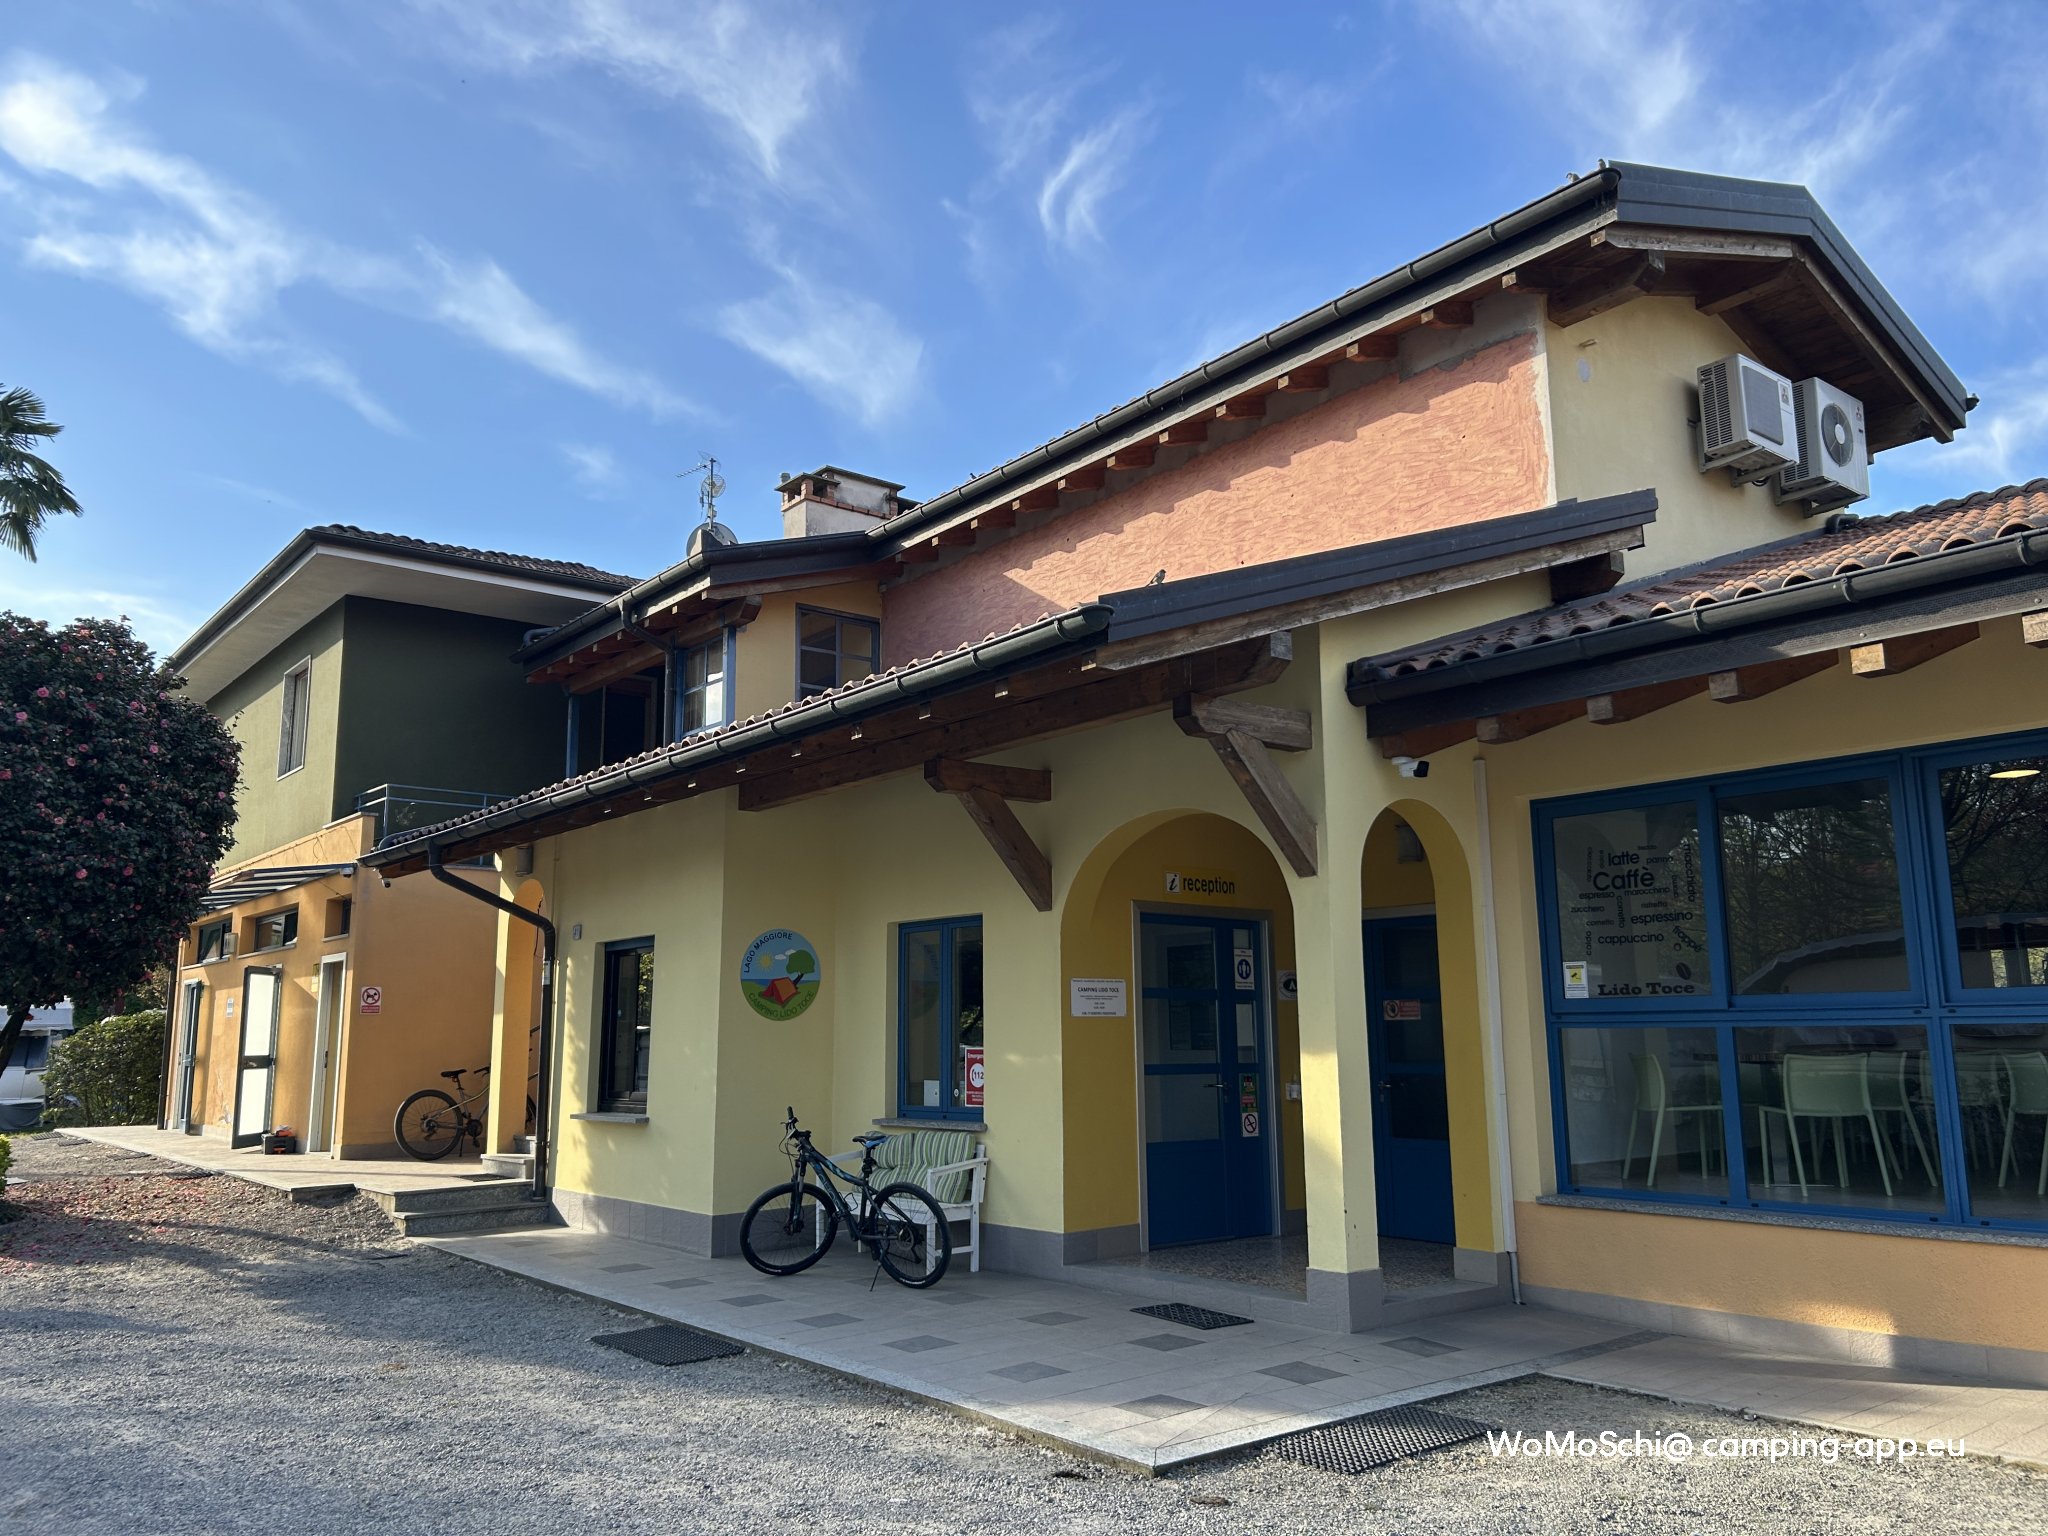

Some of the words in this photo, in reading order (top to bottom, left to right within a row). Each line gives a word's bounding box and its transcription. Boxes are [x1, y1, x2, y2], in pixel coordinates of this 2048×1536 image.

[1608, 851, 1640, 866] latte
[1183, 876, 1235, 896] reception
[1593, 866, 1655, 891] Caffè
[1578, 891, 1615, 900] espresso
[1624, 886, 1670, 897] marocchino
[1570, 904, 1605, 913] zucchero
[1630, 911, 1693, 926] espressino
[1597, 932, 1664, 945] cappuccino
[743, 950, 756, 973] LAGO
[753, 931, 793, 950] MAGGIORE
[1598, 984, 1642, 996] Lido
[1645, 982, 1696, 995] Toce
[748, 992, 779, 1017] CAMPING
[780, 1007, 797, 1018] LIDO
[798, 990, 815, 1009] TOCE
